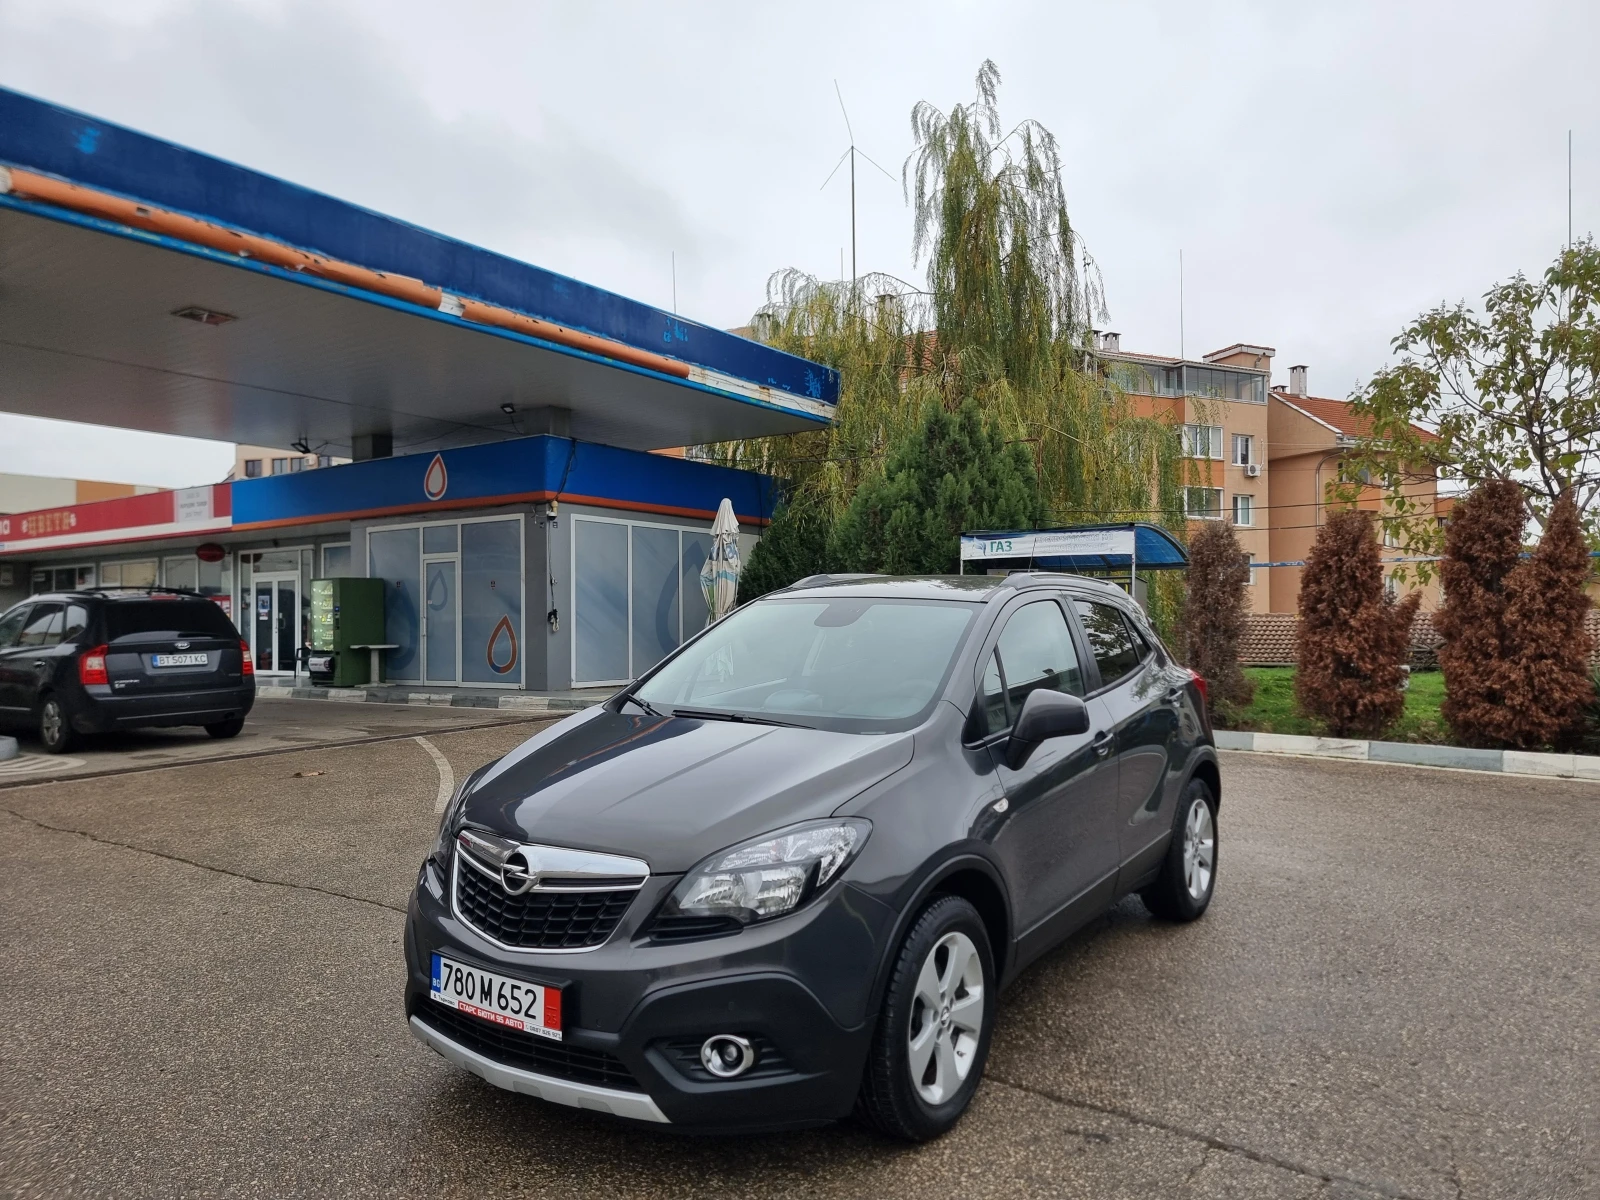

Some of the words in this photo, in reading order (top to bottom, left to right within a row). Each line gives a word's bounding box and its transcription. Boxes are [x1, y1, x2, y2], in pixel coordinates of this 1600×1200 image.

[990, 540, 1012, 553] ГАЗ
[159, 656, 170, 665] BT
[172, 655, 193, 664] 5071
[194, 654, 206, 663] KC
[432, 977, 441, 988] BG
[443, 962, 476, 1000] 780
[480, 975, 493, 1007] M
[497, 981, 537, 1020] 652
[459, 1002, 477, 1016] СТАРС
[477, 1008, 495, 1021] БЮТИ
[505, 1018, 523, 1029] АВТО
